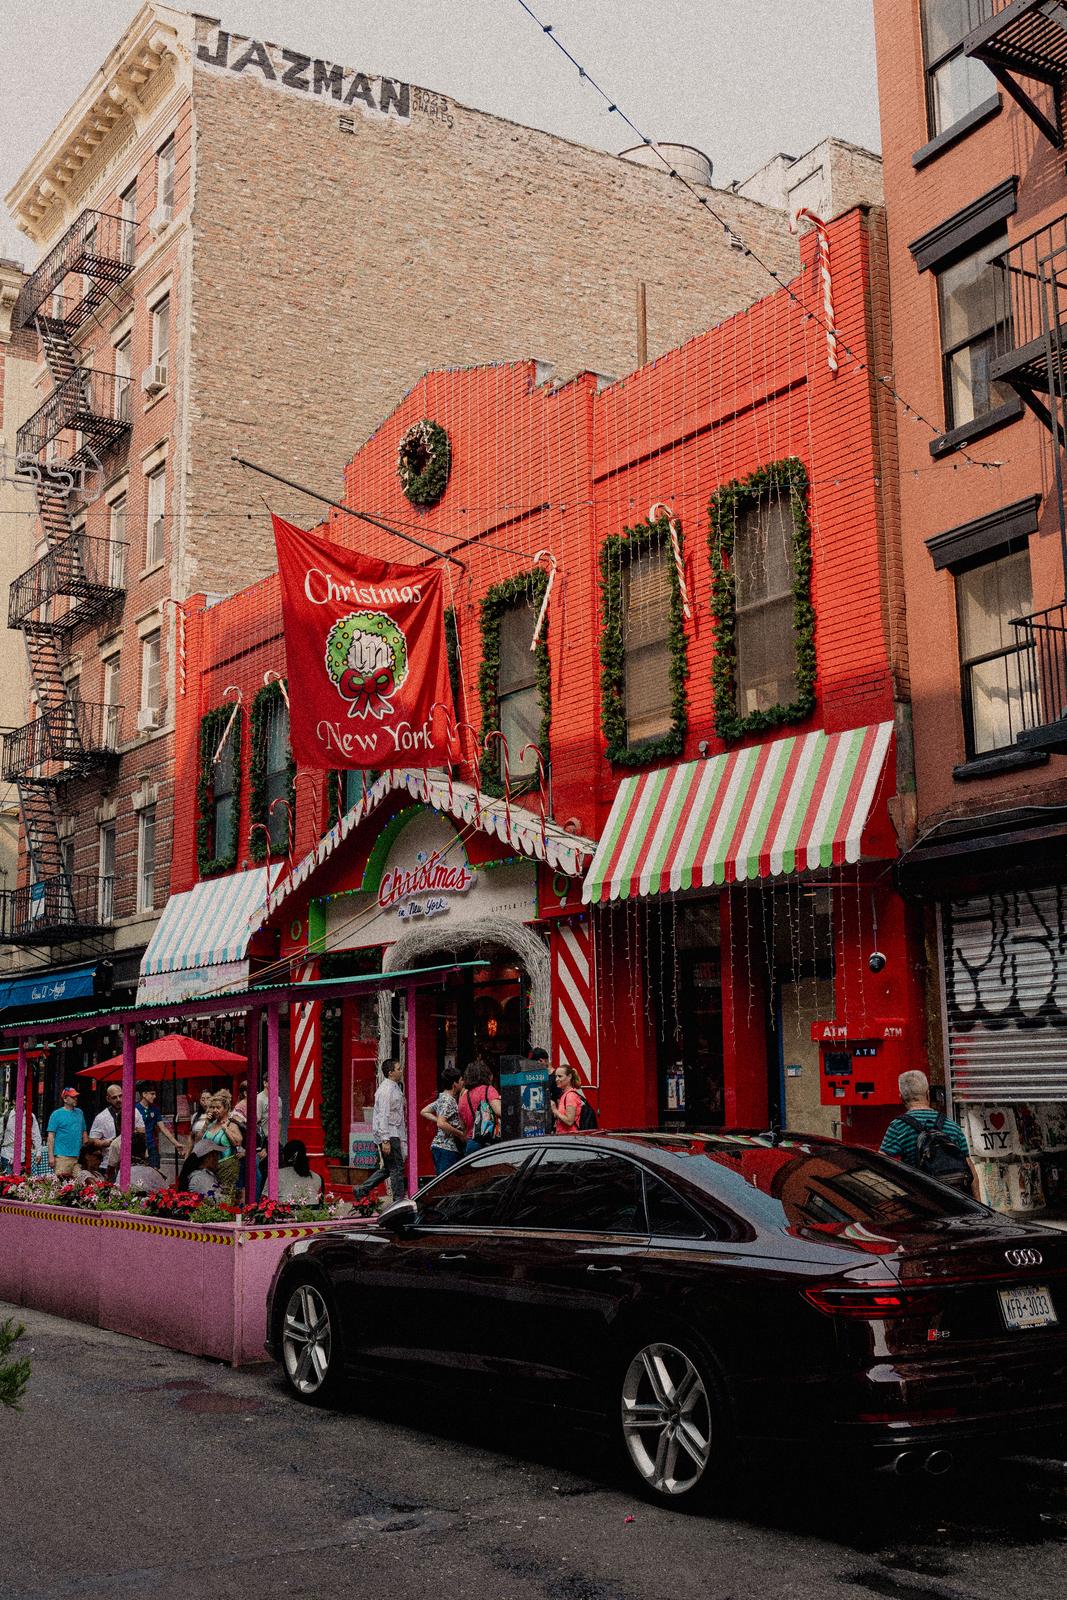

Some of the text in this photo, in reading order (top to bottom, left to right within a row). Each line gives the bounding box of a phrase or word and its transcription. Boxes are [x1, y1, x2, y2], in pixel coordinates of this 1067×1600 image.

[197, 29, 410, 119] JAZMAN
[412, 86, 449, 113] 2023
[412, 100, 454, 129] CHARLES
[304, 568, 423, 605] Christmas
[350, 629, 392, 670] in
[316, 720, 435, 758] New York
[377, 850, 472, 908] Christmas
[398, 897, 445, 917] in New York
[823, 1026, 903, 1037] ATM ATM
[855, 1048, 876, 1056] ATM
[980, 1131, 1011, 1151] NY
